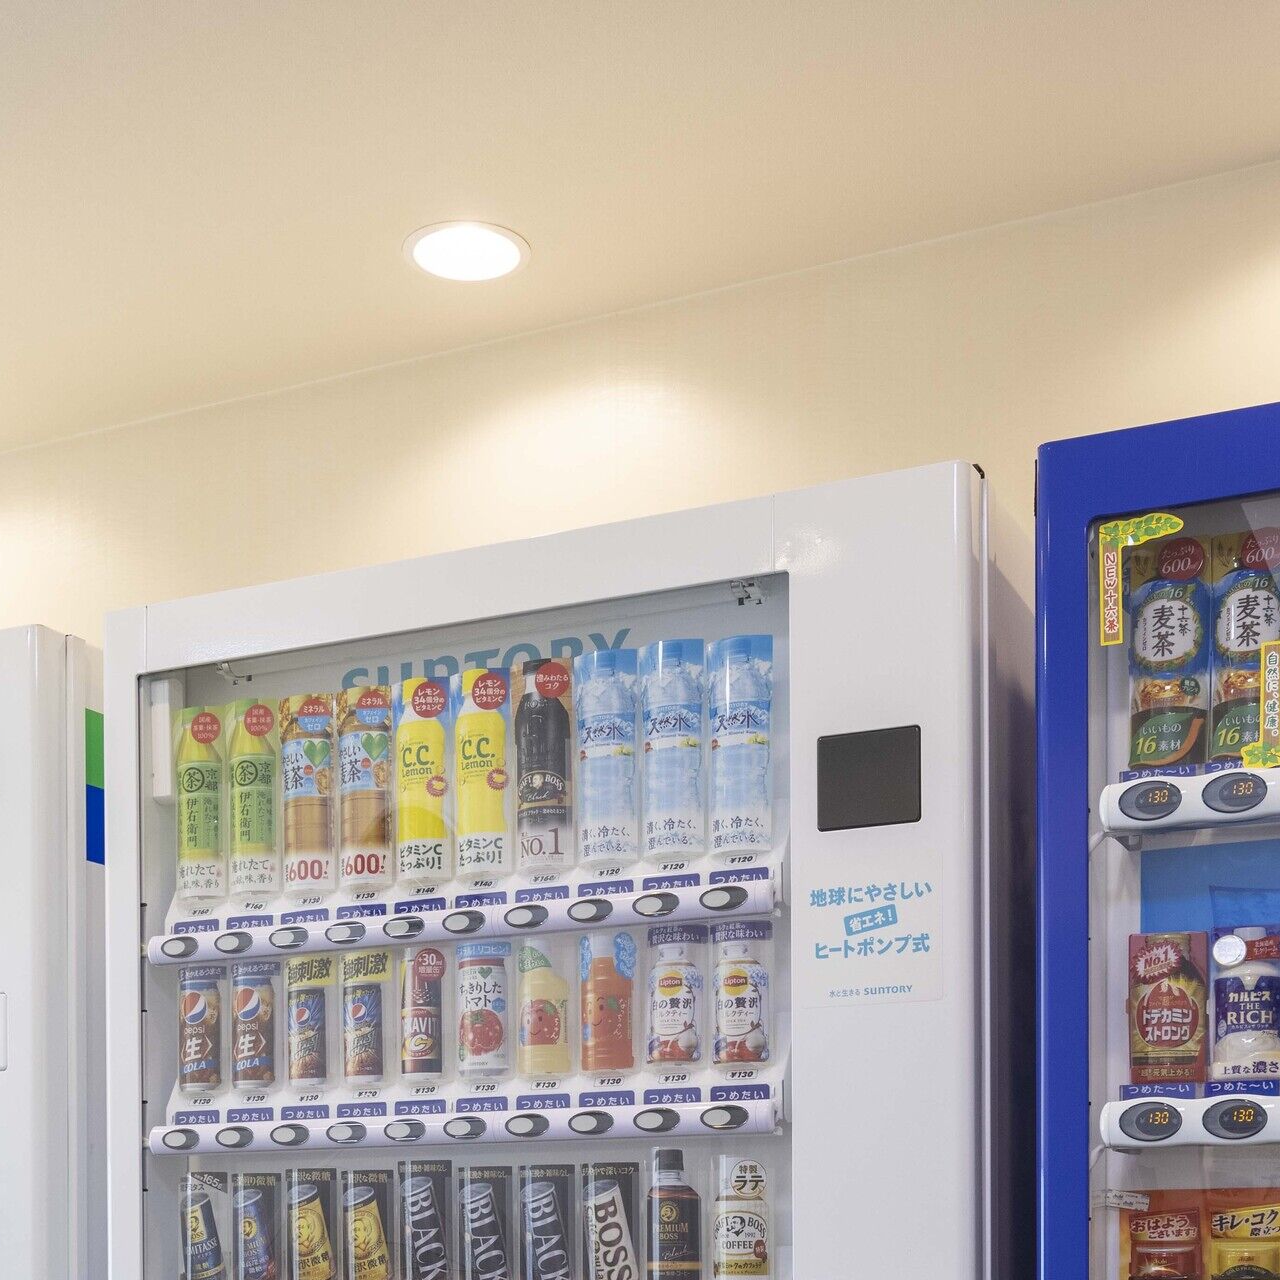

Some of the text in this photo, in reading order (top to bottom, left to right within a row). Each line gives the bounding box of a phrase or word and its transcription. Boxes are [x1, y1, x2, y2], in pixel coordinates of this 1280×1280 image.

[1237, 595, 1261, 648] 麦茶
[1151, 604, 1175, 657] 麦茶
[477, 680, 502, 688] レモン
[418, 687, 440, 696] レモン
[361, 698, 382, 707] ミネラル
[810, 881, 932, 908] 地球にやさしい
[848, 909, 894, 933] 省エネ!
[814, 932, 930, 960] ヒートポンプ式
[659, 978, 681, 986] Lipton
[864, 984, 913, 996] SUNTORY
[1229, 991, 1271, 1002] カルピス
[1142, 1010, 1192, 1025] ドデカミン
[1227, 1009, 1272, 1025] RICH
[1144, 1026, 1190, 1041] ストロング
[184, 1036, 202, 1061] 生
[237, 1034, 255, 1058] 生
[521, 1099, 565, 1108] つめたい
[584, 1096, 630, 1106] つめたい
[341, 1106, 382, 1117] つめたい
[399, 1104, 441, 1115] つめたい
[1232, 1109, 1254, 1122] 130
[1149, 1111, 1169, 1125] 130
[738, 1164, 758, 1173] 特製
[733, 1175, 764, 1191] ラテ
[1131, 1215, 1189, 1233] おはよう
